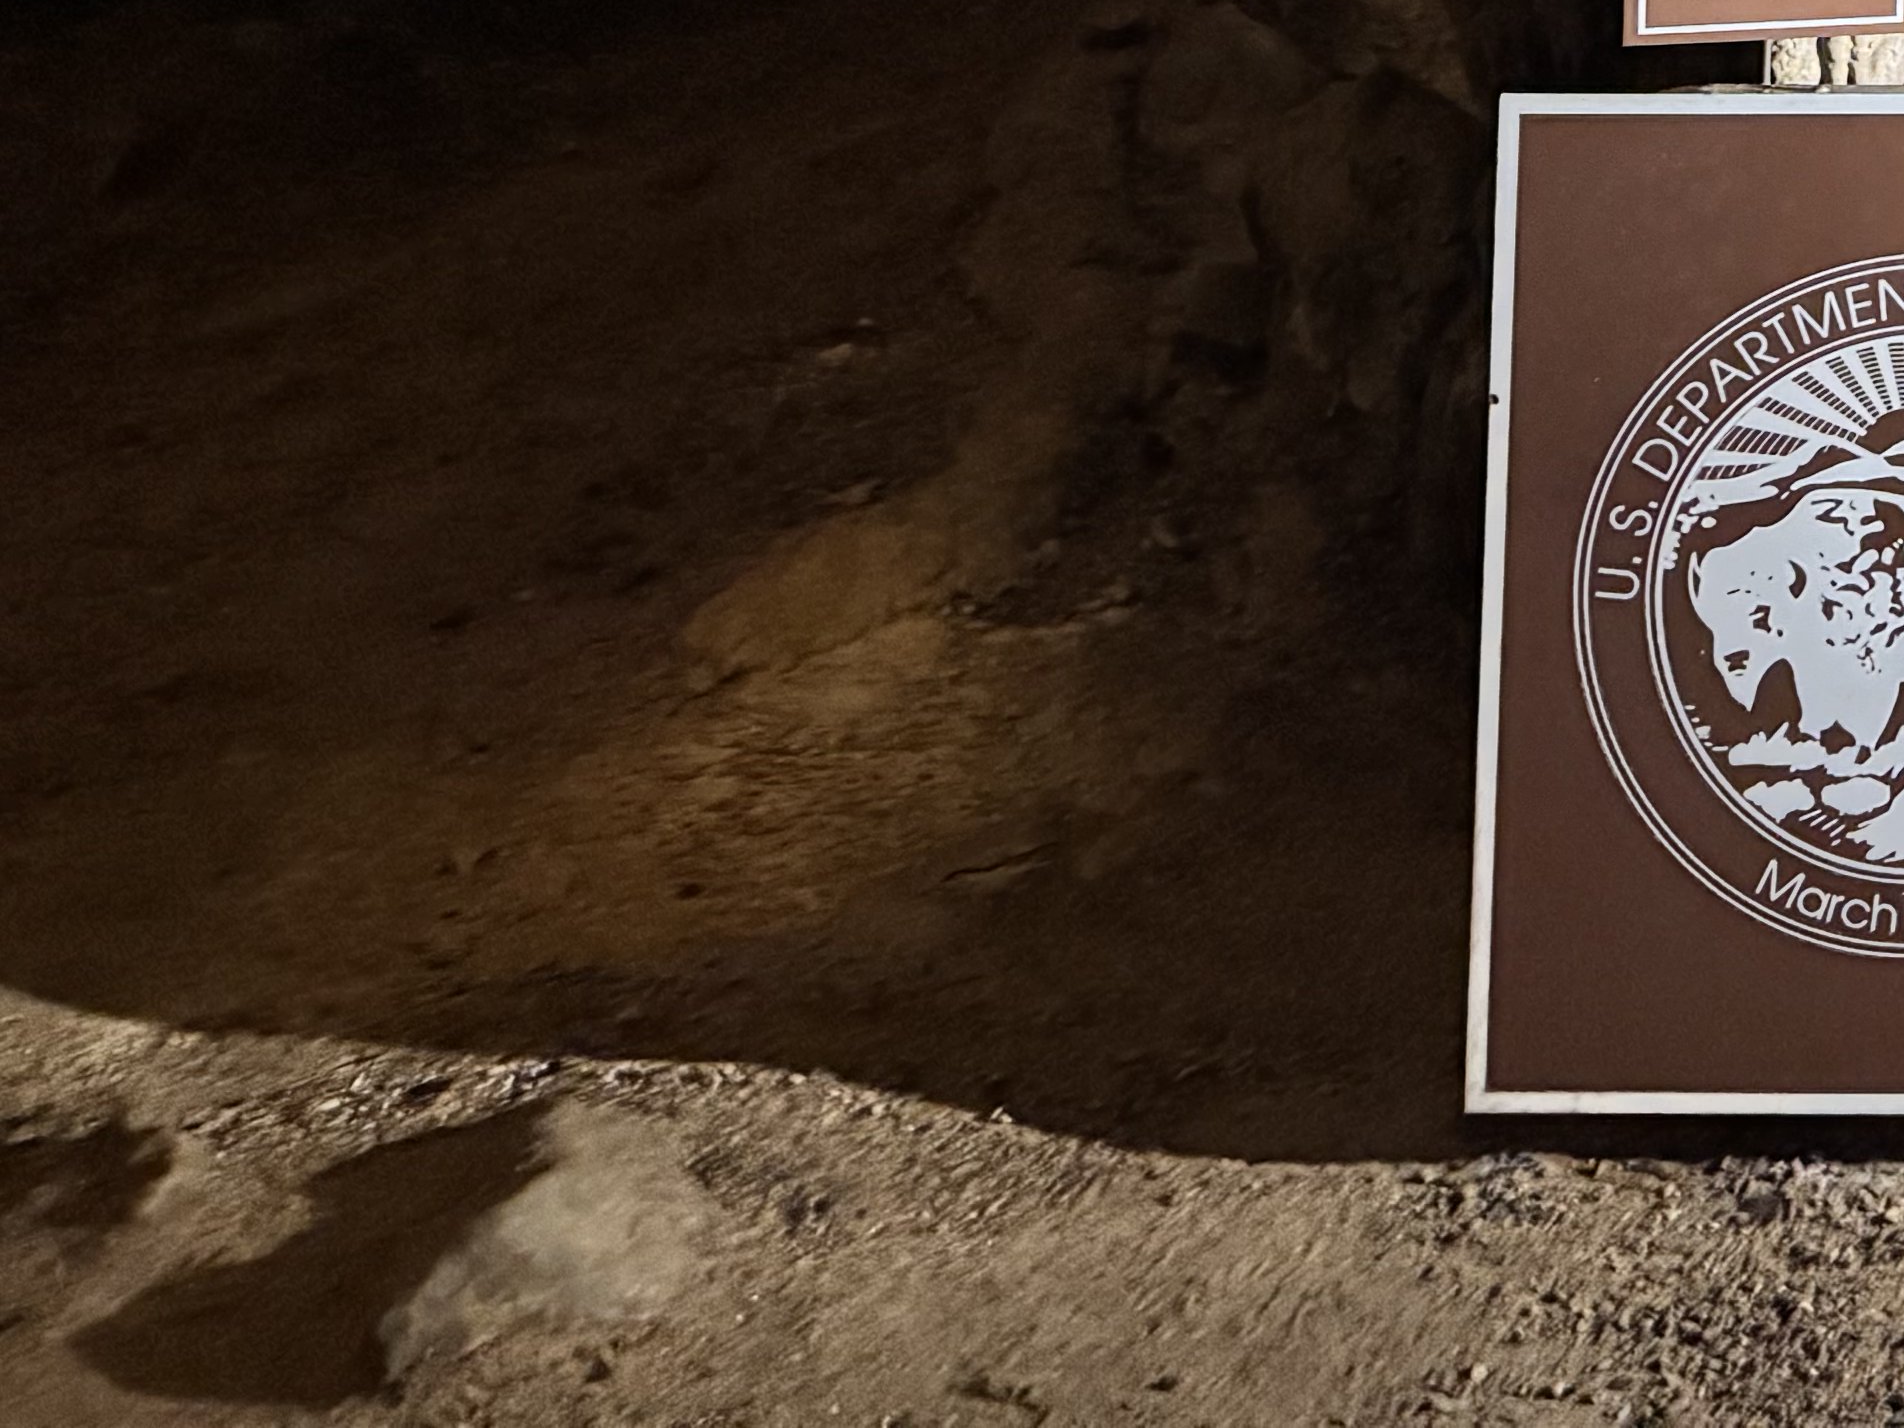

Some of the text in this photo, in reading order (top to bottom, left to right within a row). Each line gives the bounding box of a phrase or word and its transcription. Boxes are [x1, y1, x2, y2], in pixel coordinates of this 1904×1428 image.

[1608, 500, 1659, 537] S.
[1594, 556, 1643, 600] U.
[1754, 858, 1898, 936] March
